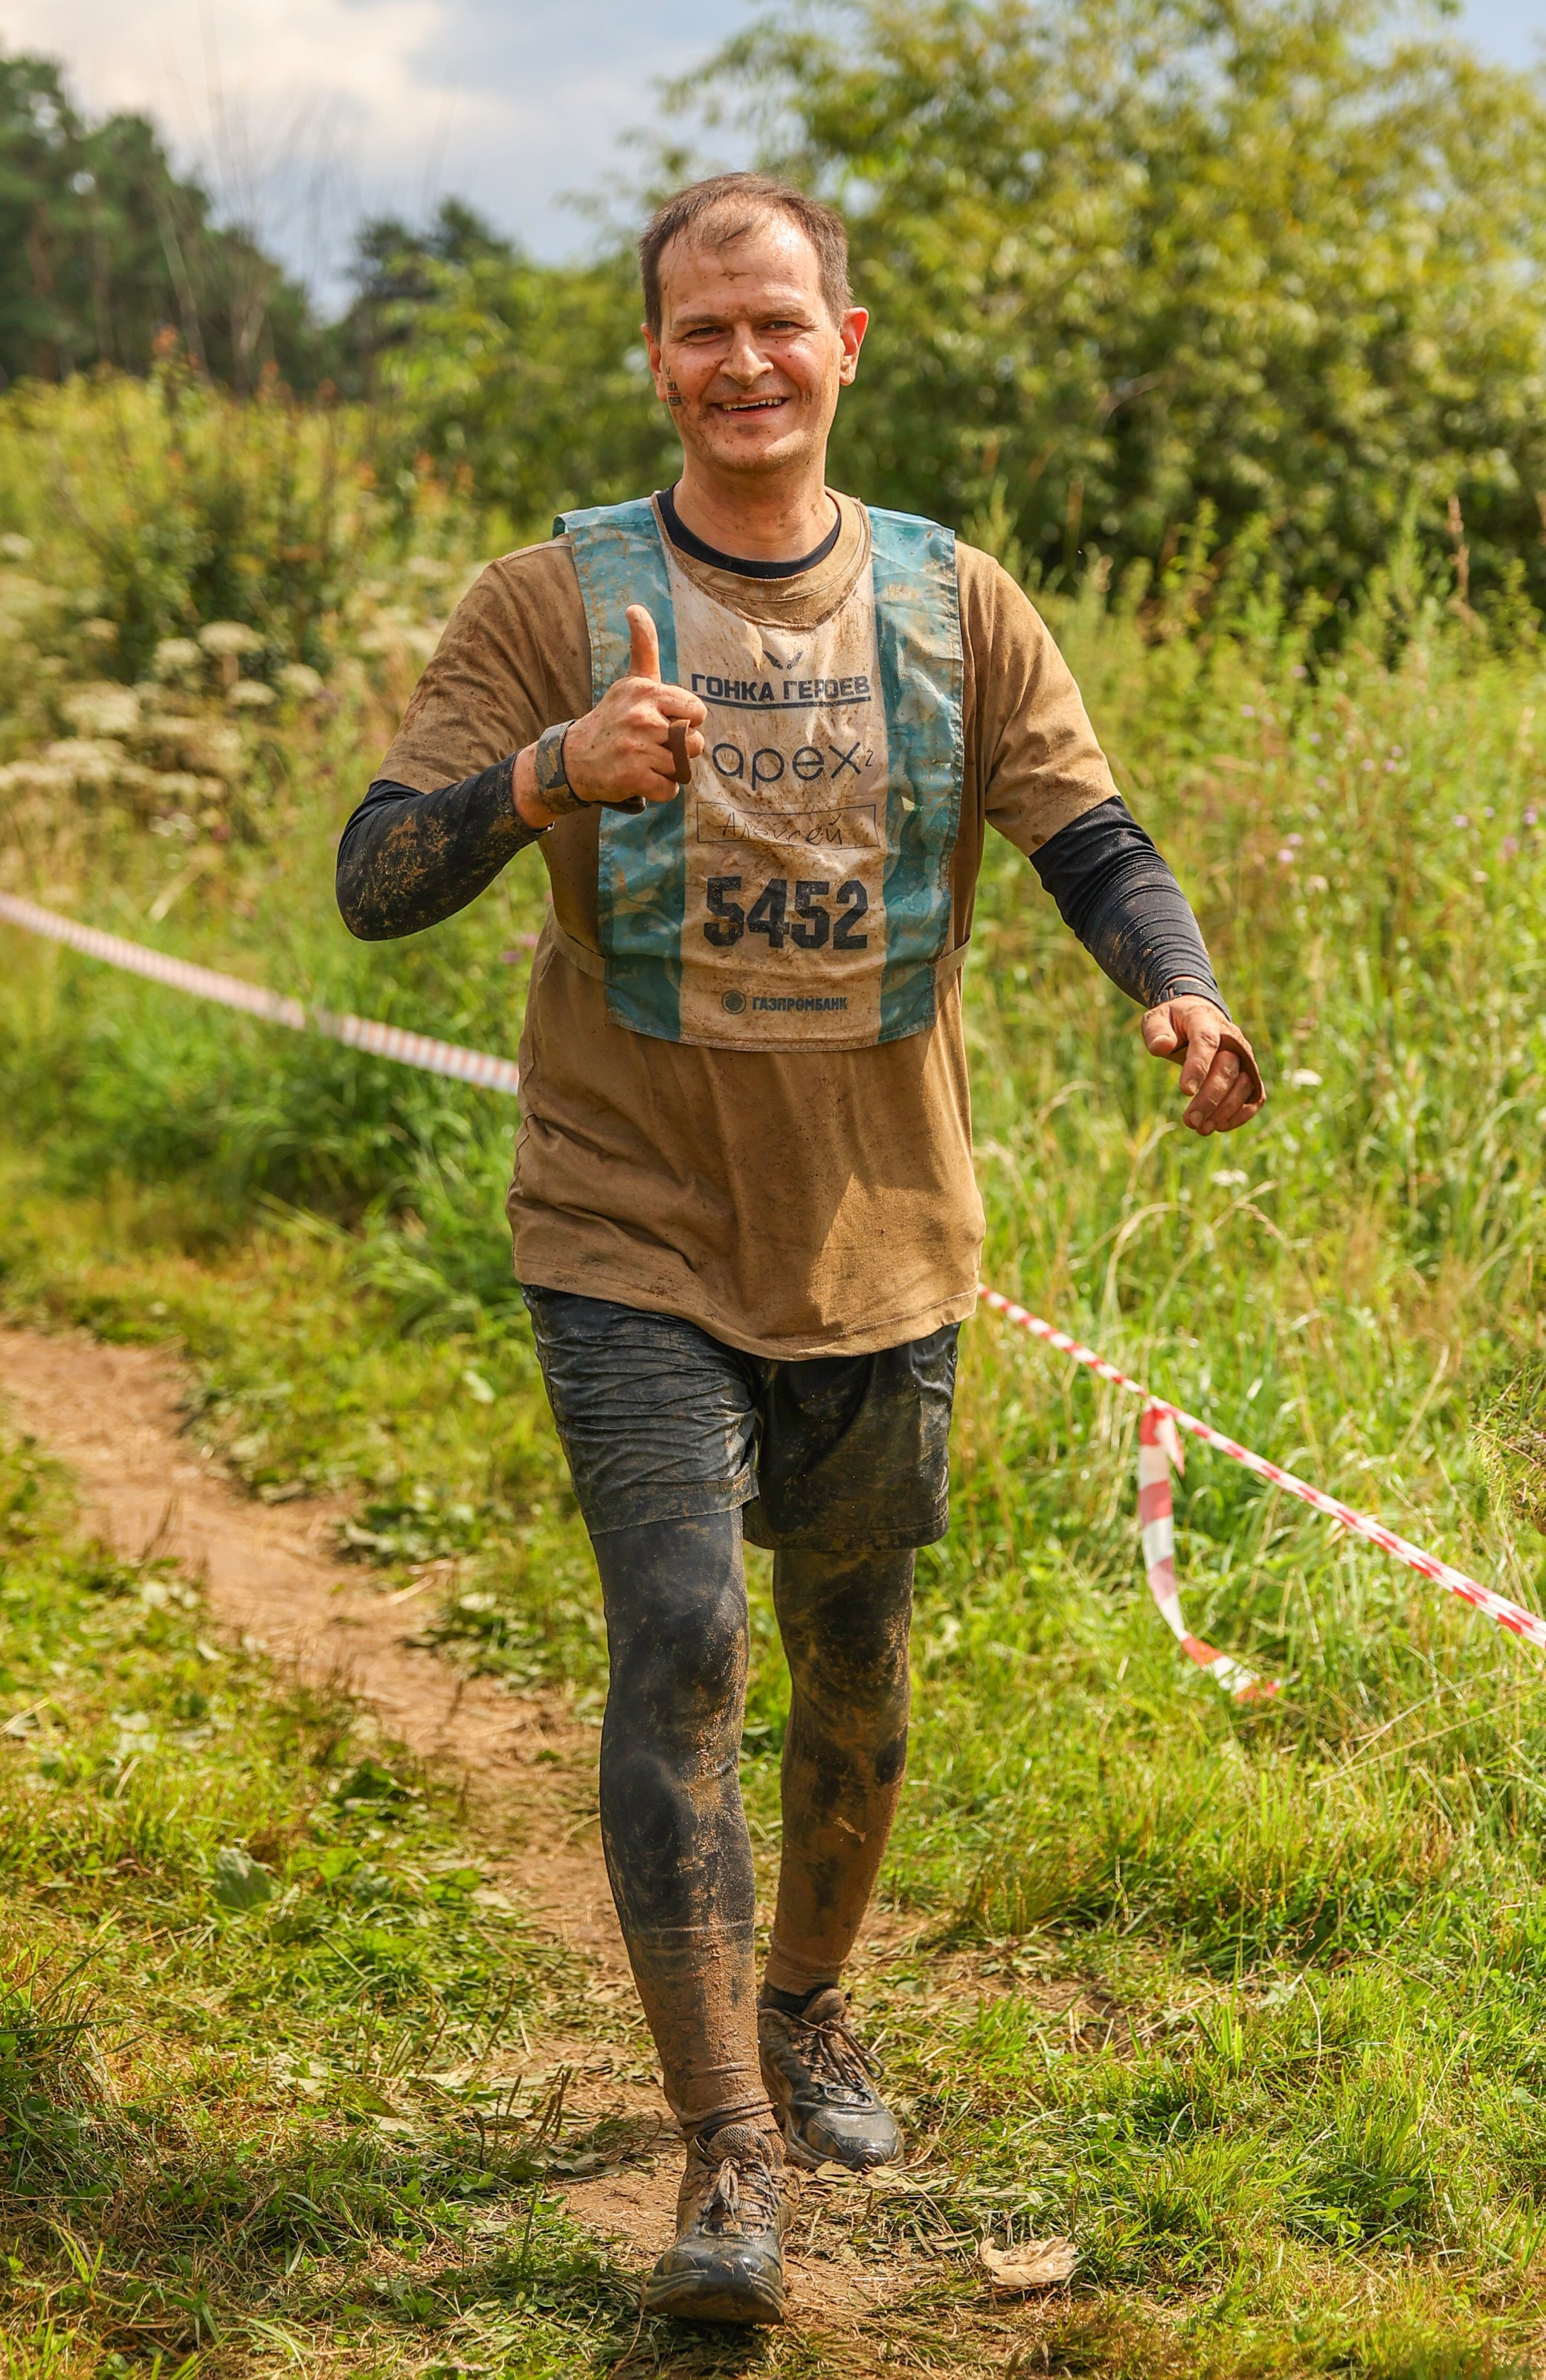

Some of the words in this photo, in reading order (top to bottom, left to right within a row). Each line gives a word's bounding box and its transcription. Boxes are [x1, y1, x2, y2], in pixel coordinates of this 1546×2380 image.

[692, 673, 775, 701] ГОНКА
[783, 675, 870, 700] ГЕРОЕВ
[712, 742, 861, 791] apex
[703, 876, 869, 950] 5452
[753, 997, 847, 1012] ГАЗПРОМБАНК
